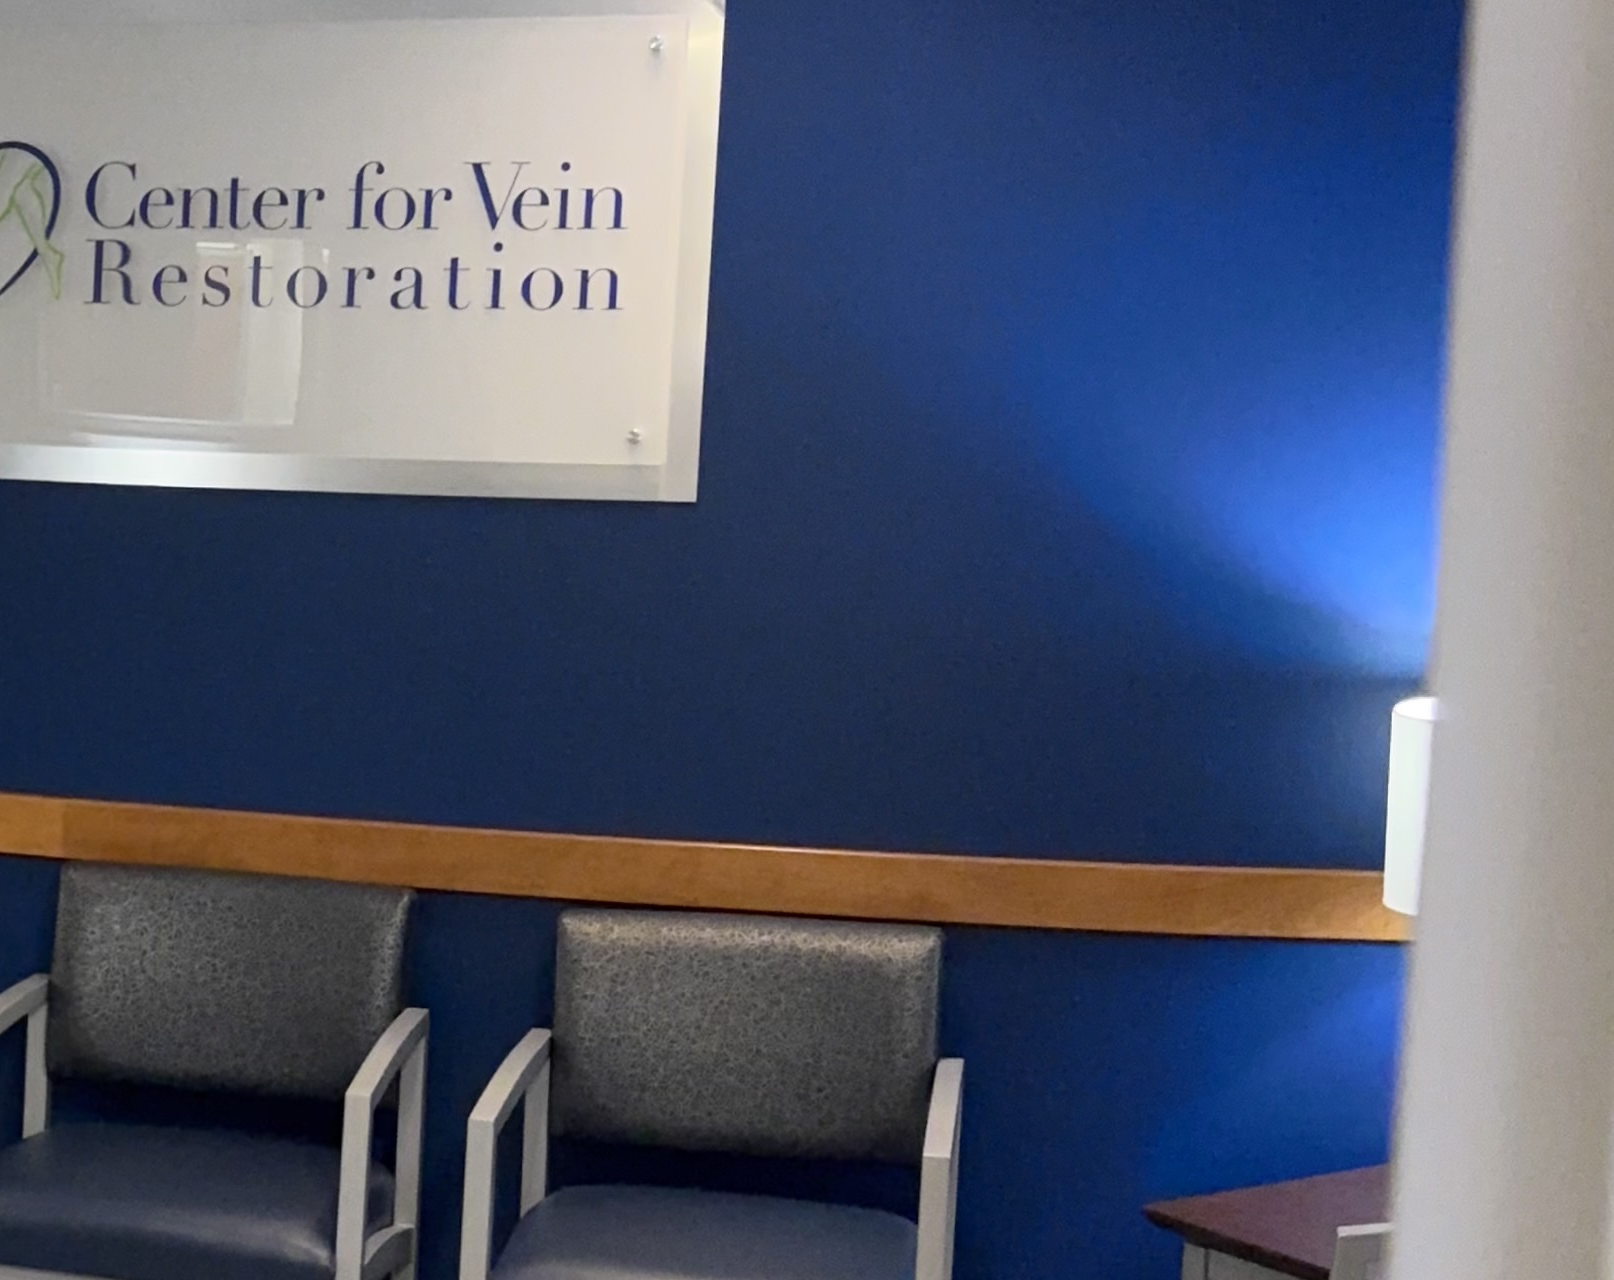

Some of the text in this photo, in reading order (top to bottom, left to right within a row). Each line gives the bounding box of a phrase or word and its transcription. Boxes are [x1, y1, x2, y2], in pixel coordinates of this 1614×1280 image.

[85, 161, 628, 232] Center for Vein
[83, 238, 624, 310] Restoration
